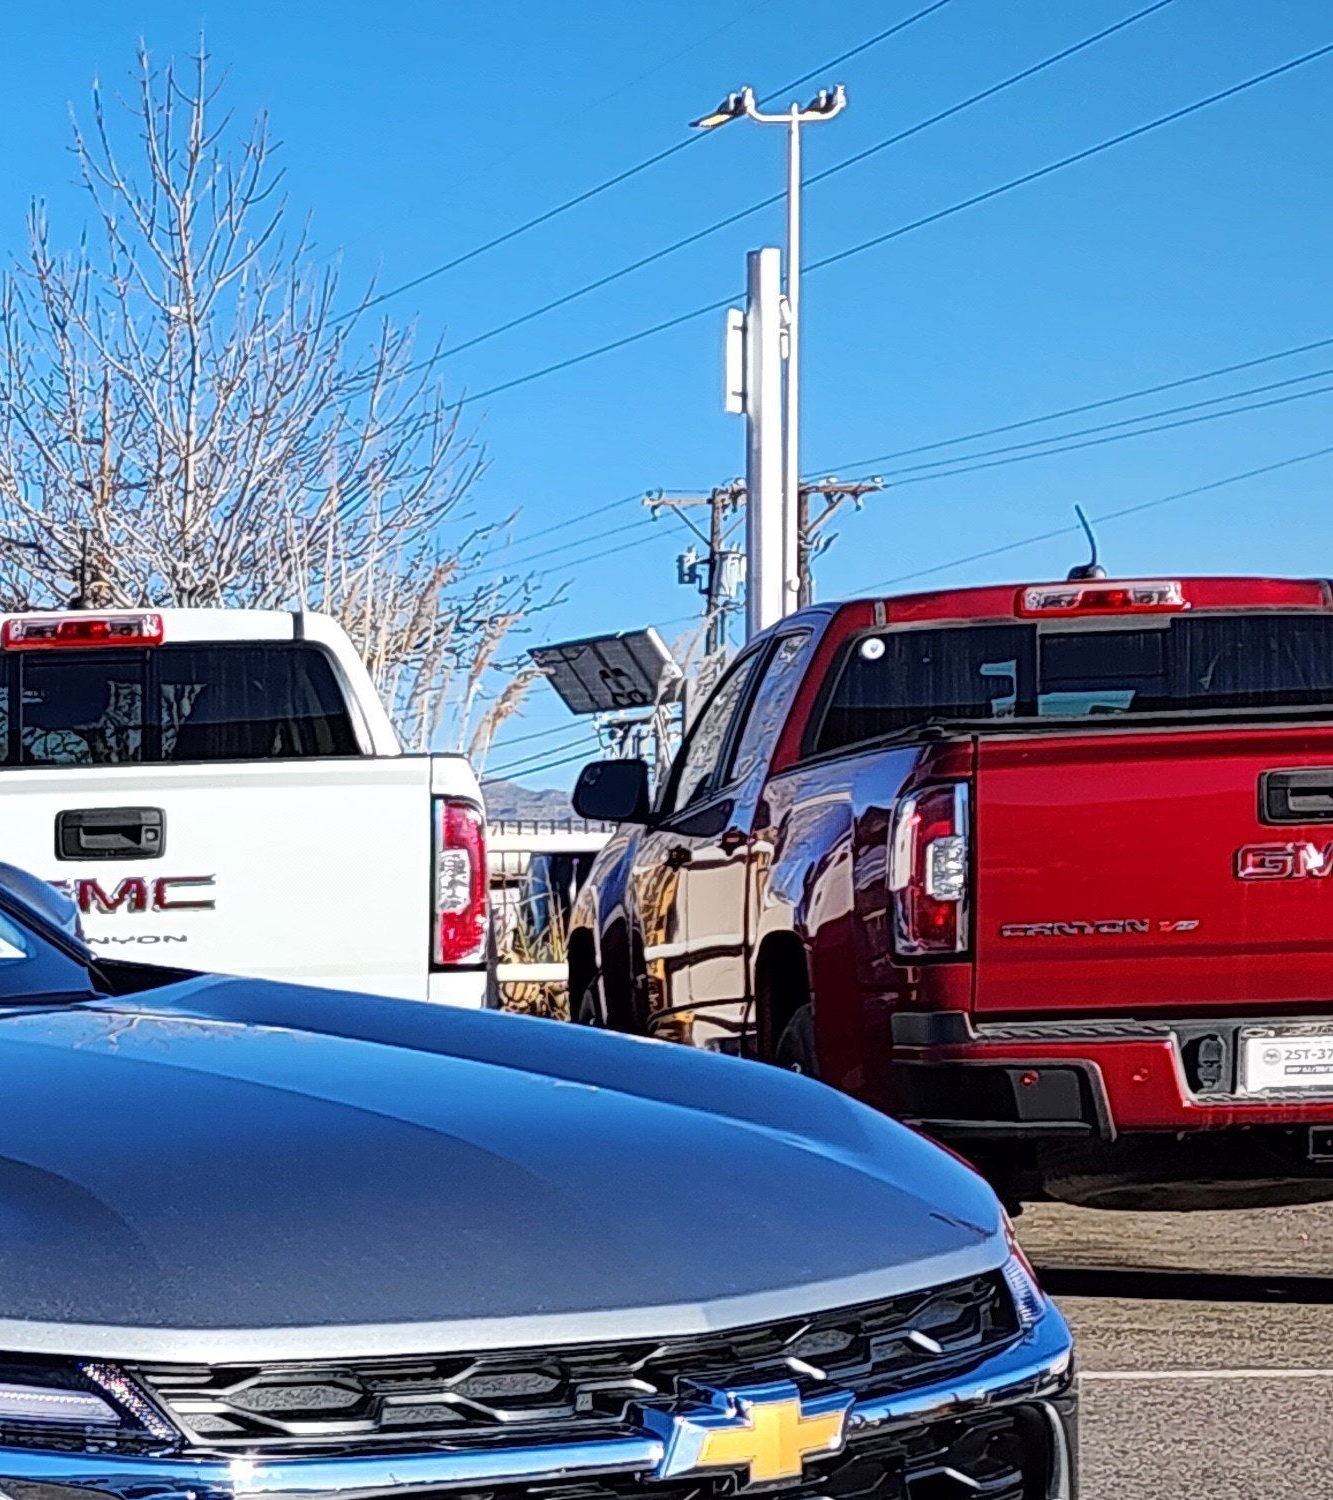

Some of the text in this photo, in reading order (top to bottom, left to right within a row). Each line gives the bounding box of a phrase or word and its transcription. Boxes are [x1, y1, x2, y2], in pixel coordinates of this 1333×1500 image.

[46, 874, 217, 914] MC
[1001, 918, 1151, 937] CANYON
[85, 935, 188, 945] NYON
